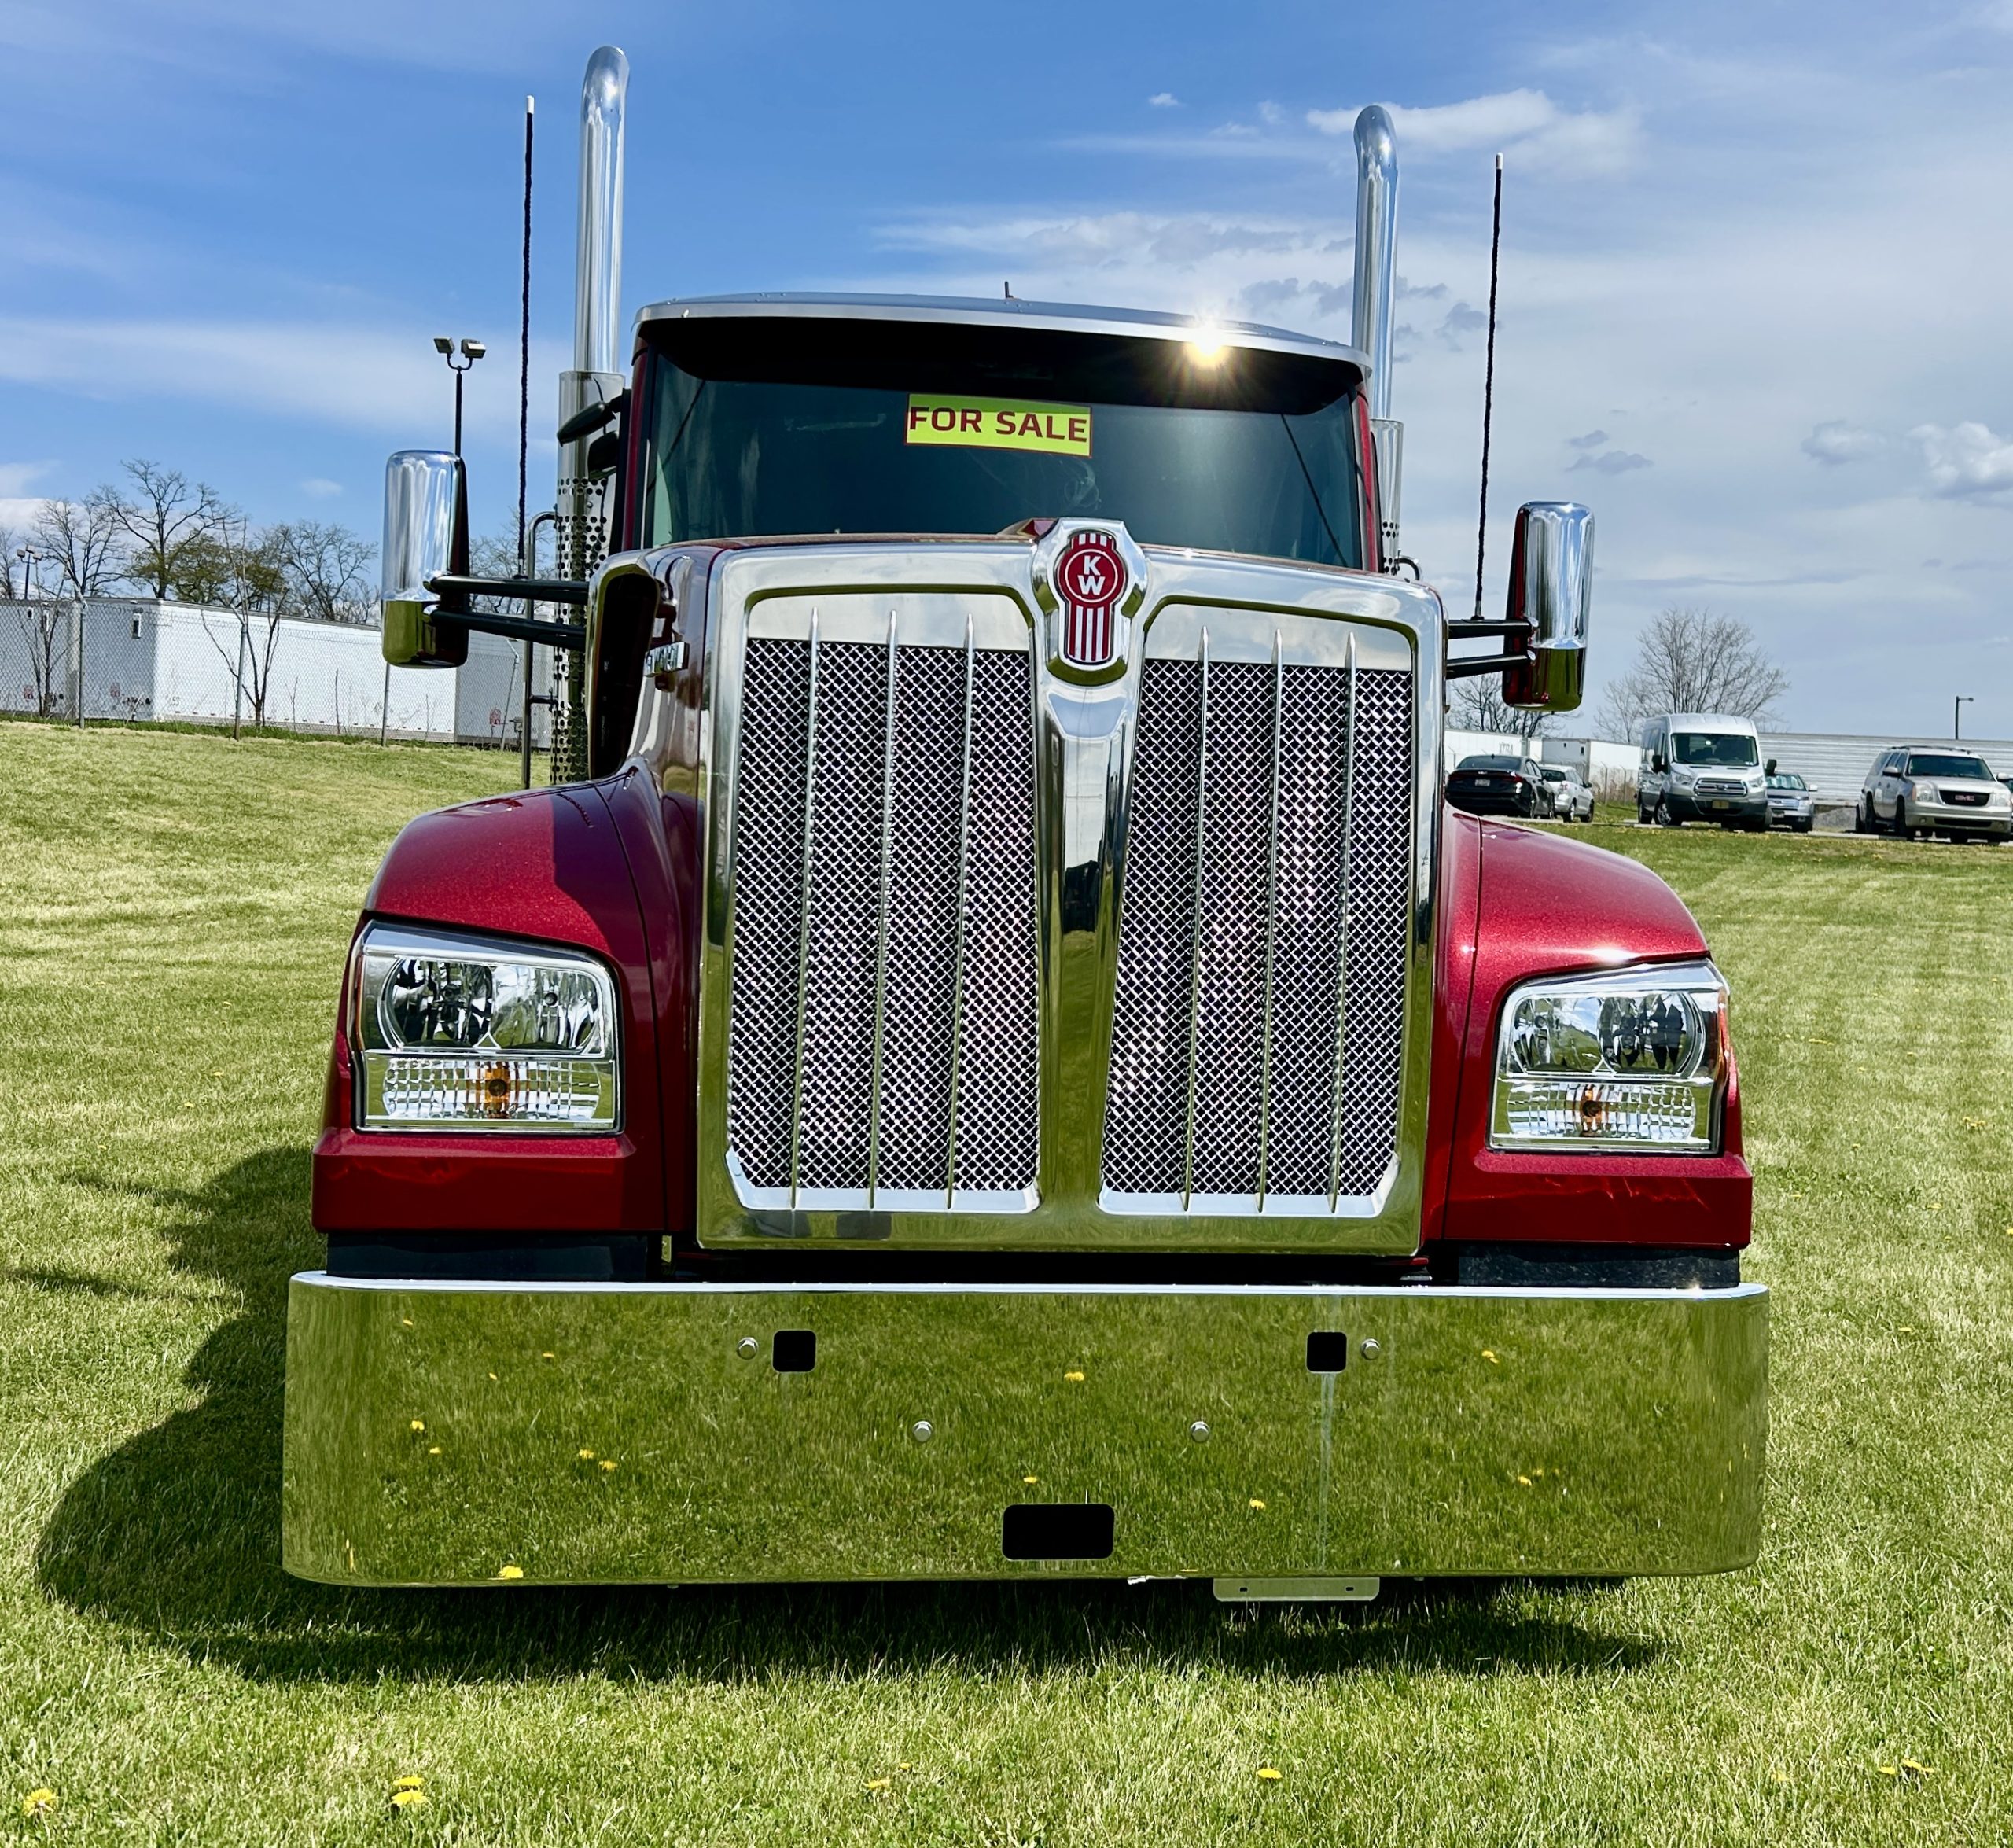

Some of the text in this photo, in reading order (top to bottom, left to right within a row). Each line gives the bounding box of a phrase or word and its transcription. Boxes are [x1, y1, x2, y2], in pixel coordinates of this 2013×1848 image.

[910, 406, 1087, 443] FOR SALE
[1084, 555, 1101, 576] K
[1077, 575, 1106, 595] W
